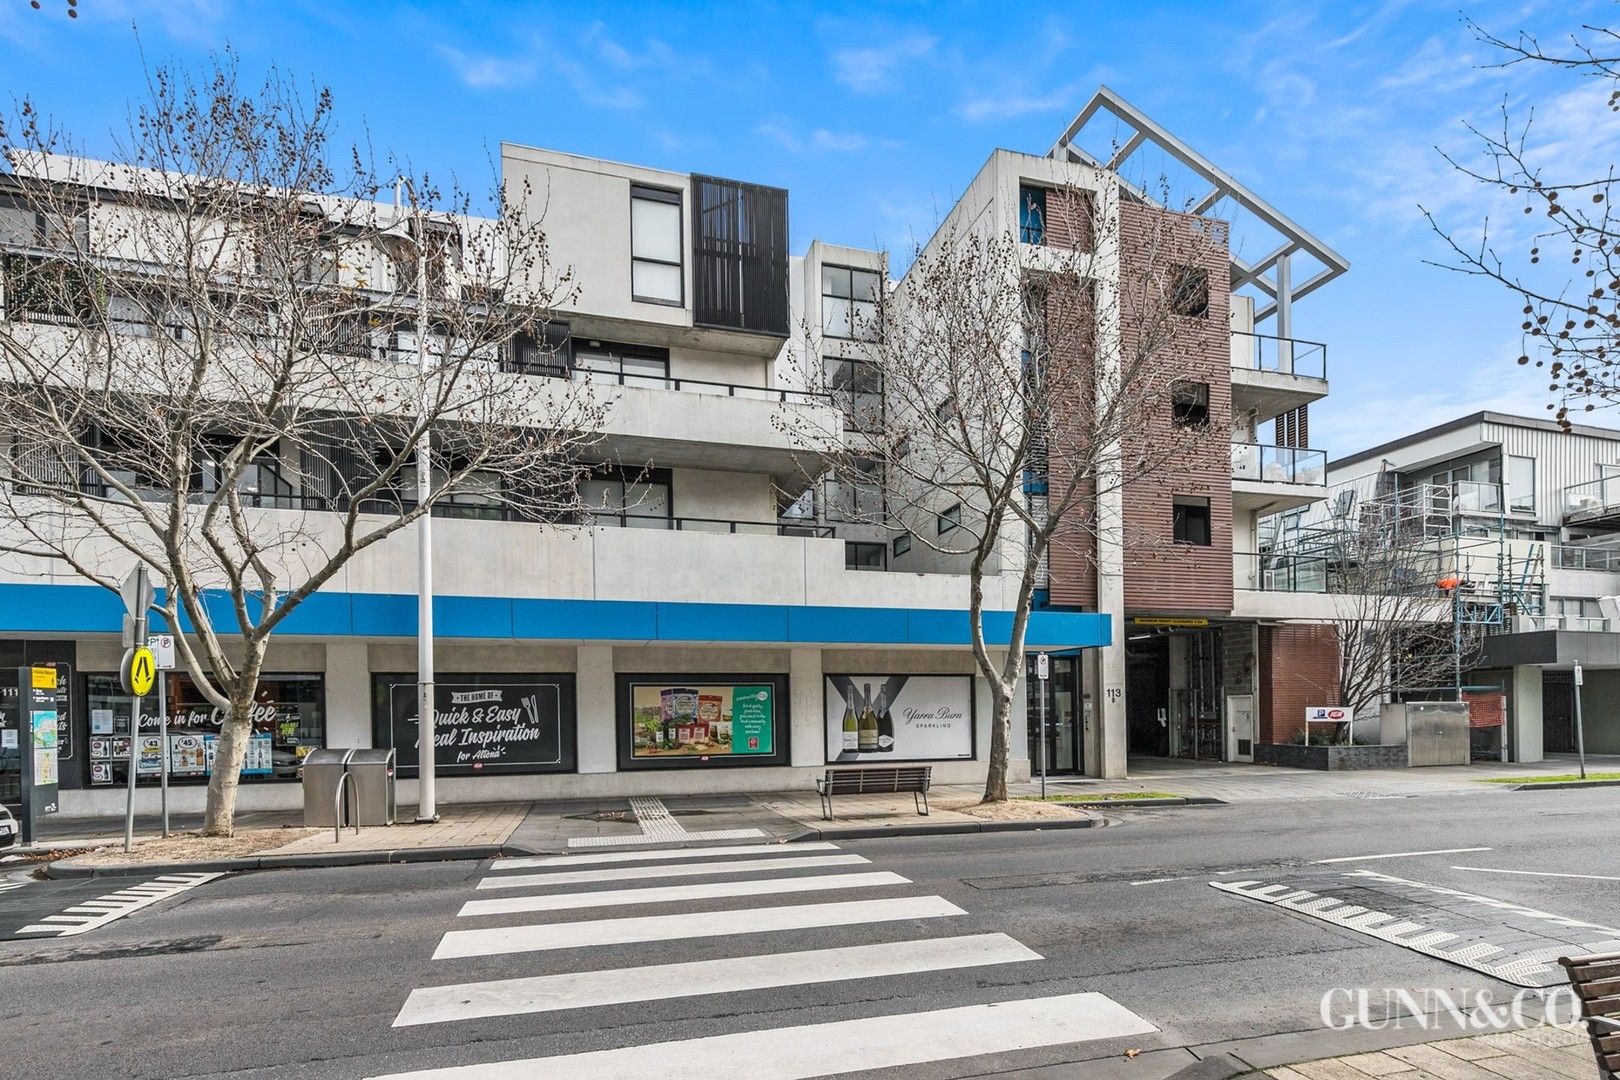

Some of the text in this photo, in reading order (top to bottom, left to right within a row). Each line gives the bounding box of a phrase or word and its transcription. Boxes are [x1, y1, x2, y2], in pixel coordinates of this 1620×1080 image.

[2, 688, 19, 696] 111
[461, 694, 470, 702] THE
[471, 693, 486, 701] HOME
[1107, 689, 1121, 697] 113
[173, 710, 186, 725] in
[188, 711, 208, 727] for
[211, 700, 276, 725] Cfee
[472, 707, 485, 723] &
[486, 705, 521, 725] Easy
[903, 706, 962, 725] Yarra Burn
[458, 723, 540, 748] Inspiration
[457, 749, 500, 763] for Altona
